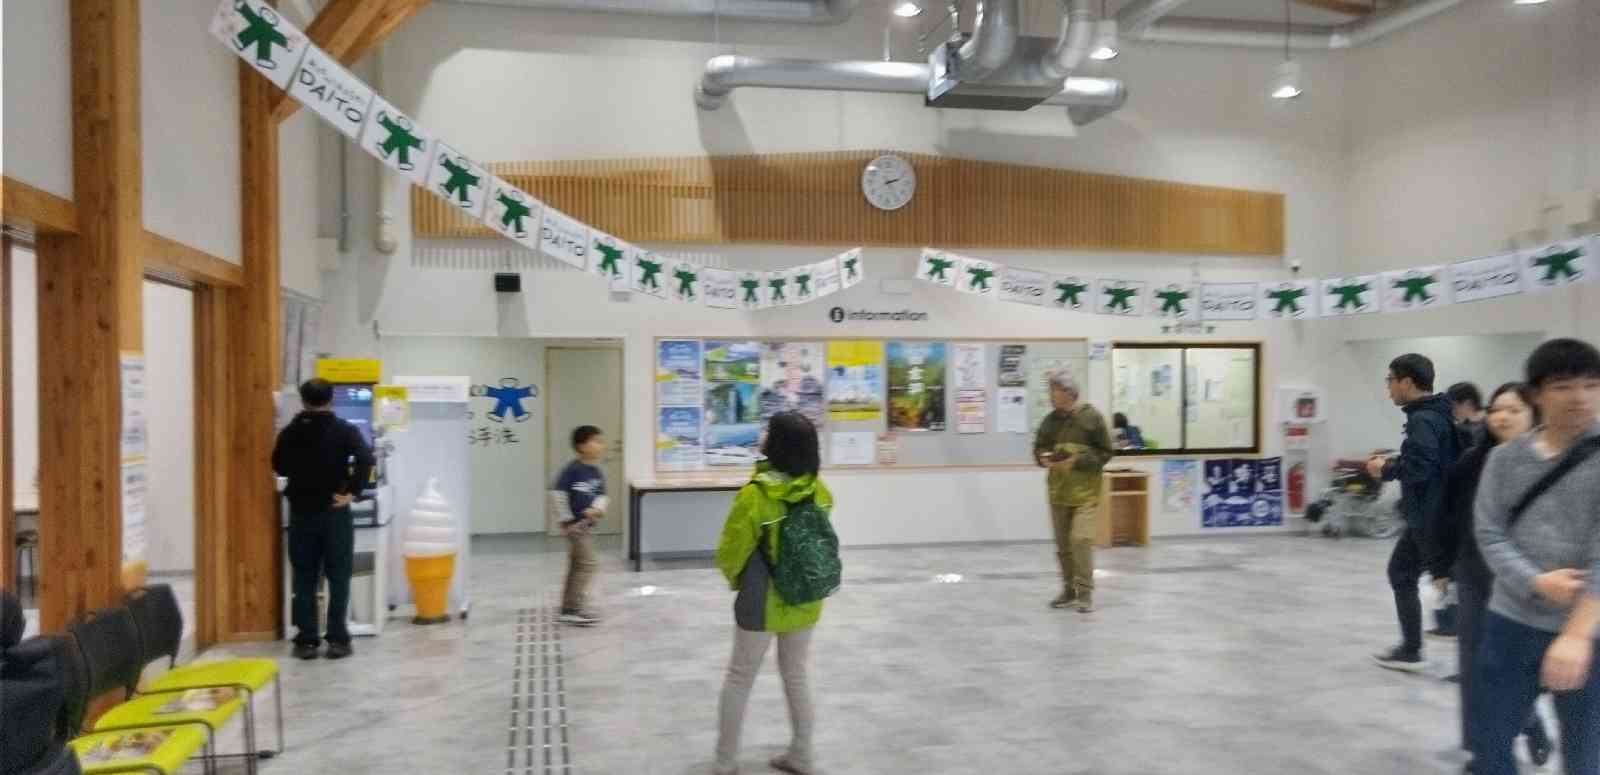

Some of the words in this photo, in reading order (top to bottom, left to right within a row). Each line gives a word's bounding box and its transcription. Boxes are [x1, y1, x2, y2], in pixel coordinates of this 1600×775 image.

[299, 67, 362, 123] DAITO
[541, 227, 585, 257] DAITO
[999, 273, 1046, 297] DAITO
[1451, 271, 1516, 292] DAITO
[1200, 299, 1255, 311] DAITO
